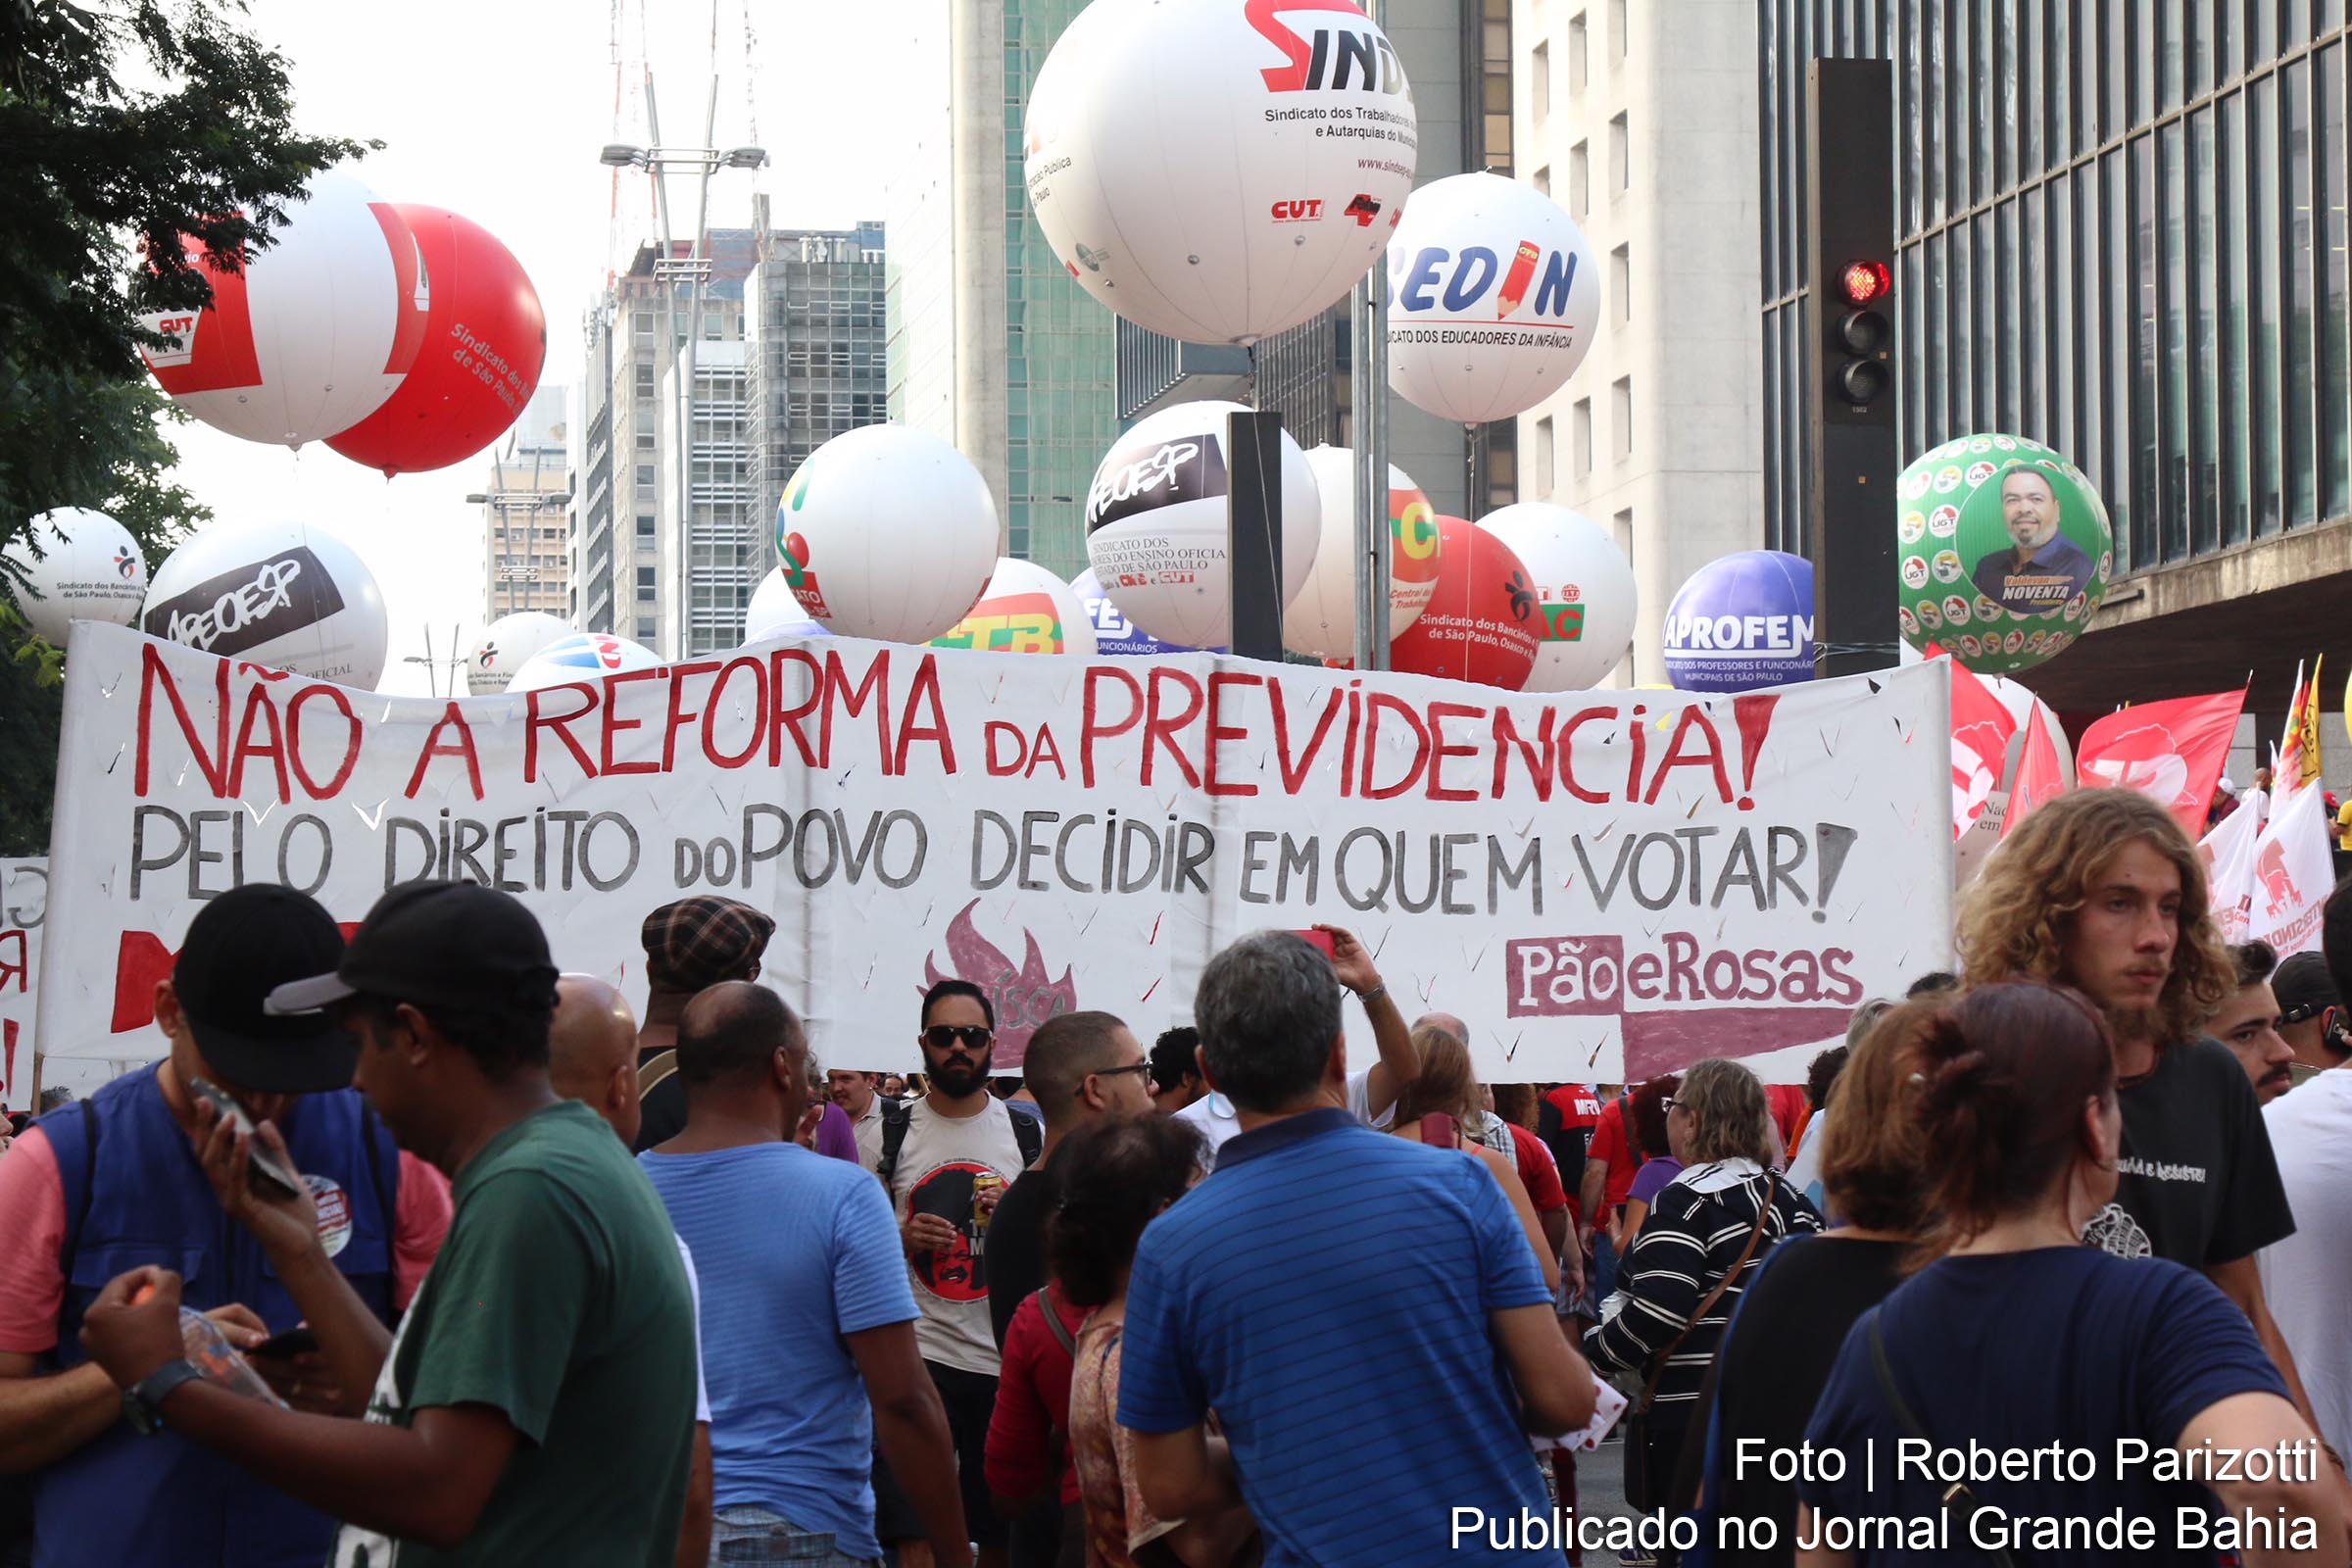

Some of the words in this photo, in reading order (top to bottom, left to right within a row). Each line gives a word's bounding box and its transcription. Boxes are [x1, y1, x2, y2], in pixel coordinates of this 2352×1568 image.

[1265, 108, 1327, 122] Sindicato
[1331, 107, 1352, 119] dos
[1315, 128, 1324, 137] e
[1326, 124, 1386, 140] Autarquias
[1388, 129, 1396, 142] do
[1271, 200, 1321, 219] CUT
[1416, 330, 1438, 343] DOS
[1442, 330, 1517, 346] EDUCADORES
[1518, 333, 1534, 347] DA
[1536, 331, 1573, 349] INFÂNCIA
[451, 323, 509, 375] Sindicato
[453, 349, 473, 368] de
[472, 362, 494, 386] São
[1932, 518, 1955, 528] UGT
[1144, 537, 1169, 549] DOS
[1113, 552, 1127, 563] DO
[1130, 549, 1175, 562] ENSINO
[1177, 548, 1226, 560] OFICIA
[1122, 562, 1137, 573] DE
[1138, 559, 1161, 571] SÃO
[1164, 560, 1208, 570] PAULO
[1905, 569, 1926, 580] UGT
[2002, 585, 2070, 601] NOVENTA
[1946, 609, 1968, 617] UGT
[1420, 613, 1474, 628] Sindicato
[1476, 616, 1495, 631] dos
[1497, 621, 1533, 644] Bancários
[1097, 640, 1158, 654] UNCIONÁRIOS
[1429, 628, 1444, 640] de
[1446, 628, 1465, 642] São
[1468, 631, 1499, 647] Paulo,
[1500, 638, 1523, 654] Osasco
[1697, 660, 1754, 670] PROFESSORES
[1755, 660, 1760, 669] E
[1763, 659, 1814, 670] FUNCIONÁRI
[1725, 671, 1735, 681] DE
[1736, 670, 1753, 681] SÃO
[1755, 671, 1783, 682] PAULO
[134, 642, 363, 804] NÃO
[404, 702, 485, 802] A
[525, 648, 956, 783] REFORMA
[985, 720, 1066, 780] DA
[129, 805, 333, 901] PELO
[1239, 831, 1320, 906] EM
[1334, 826, 1544, 916] QUEM
[1571, 822, 1858, 924] VOTAR!
